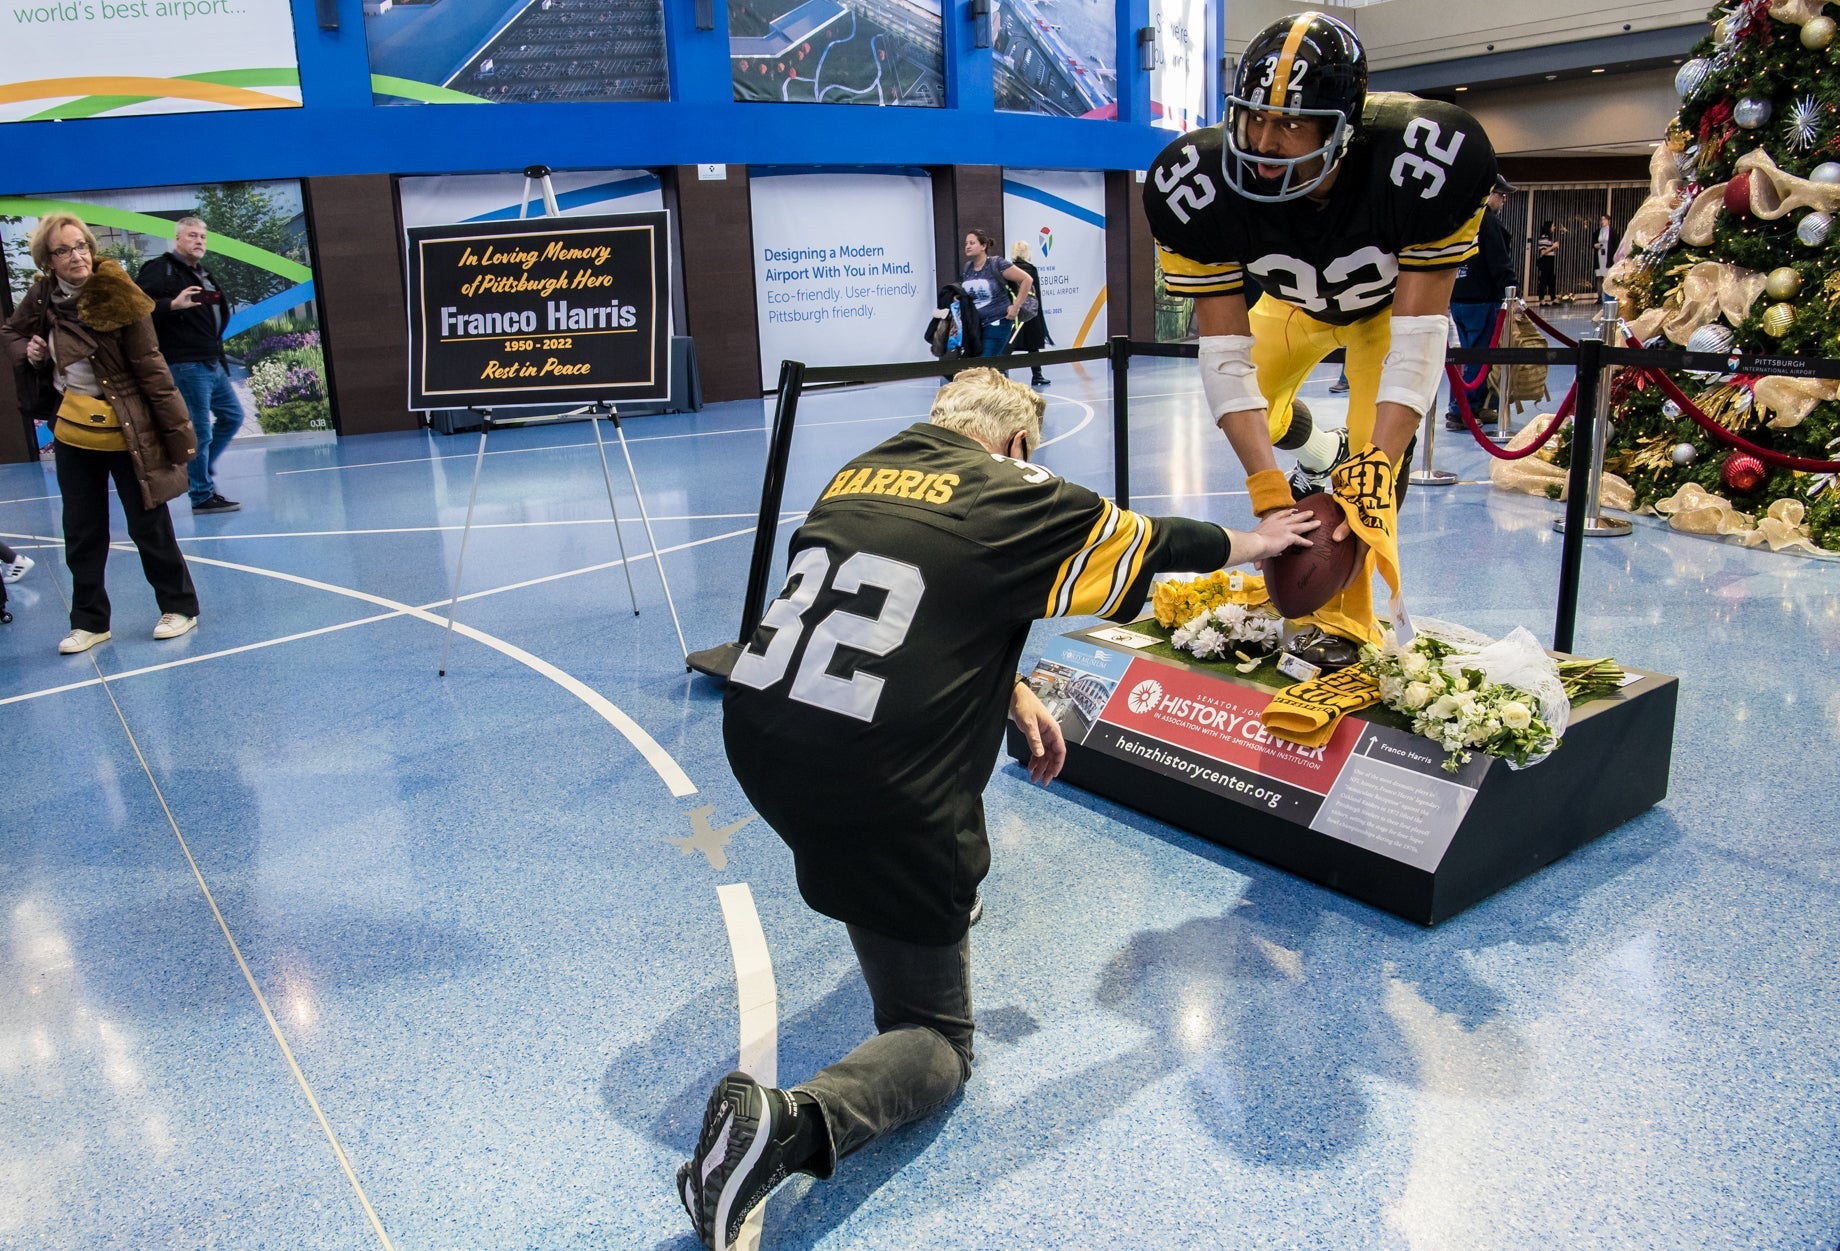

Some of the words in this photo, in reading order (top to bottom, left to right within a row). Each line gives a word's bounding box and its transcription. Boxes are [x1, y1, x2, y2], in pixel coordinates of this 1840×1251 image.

[13, 0, 95, 23] world's
[102, 0, 150, 20] best
[1390, 116, 1465, 199] 32
[1154, 144, 1216, 224] 32
[458, 247, 478, 267] In
[481, 245, 538, 269] Loving
[540, 241, 611, 266] Memory
[764, 247, 826, 263] Designing
[829, 250, 836, 259] a
[839, 245, 884, 258] Modern
[461, 274, 481, 297] of
[479, 270, 568, 297] Pittsburgh
[571, 268, 613, 290] Hero
[765, 268, 809, 283] Airport
[812, 265, 841, 279] With
[844, 264, 866, 277] You
[868, 264, 879, 276] in
[882, 262, 914, 275] Mind.
[1040, 275, 1069, 286] SBURGH
[1247, 246, 1399, 313] 32
[767, 287, 843, 303] Eco-friendly.
[845, 282, 919, 298] User-friendly.
[1057, 287, 1079, 295] AIRPORT
[441, 306, 537, 336] Franco
[547, 299, 637, 331] Harris
[769, 307, 829, 323] Pittsburgh
[832, 304, 876, 320] friendly.
[504, 340, 533, 352] 1950
[543, 338, 573, 350] 2022
[480, 360, 521, 380] Rest
[522, 361, 538, 377] in
[540, 357, 591, 377] Peace
[1742, 366, 1789, 374] INTERNATIONAL
[1790, 368, 1816, 376] AIRPORT
[1755, 359, 1805, 368] PITTSBURGH
[821, 468, 960, 505] HARRIS
[730, 547, 926, 723] 32
[1158, 694, 1243, 733] HISTORY
[1196, 694, 1238, 711] SENATOR
[1154, 711, 1161, 719] IN
[1161, 714, 1201, 733] ASSOCIATION
[1201, 728, 1219, 737] WITH
[1219, 732, 1231, 741] THE
[1231, 737, 1276, 756] SMITHSONIAN
[1276, 751, 1322, 770] INSTITUTION
[1380, 743, 1406, 757] Franco
[1407, 751, 1433, 764] Harris
[1115, 736, 1282, 808] heinzhistorycenter.org
